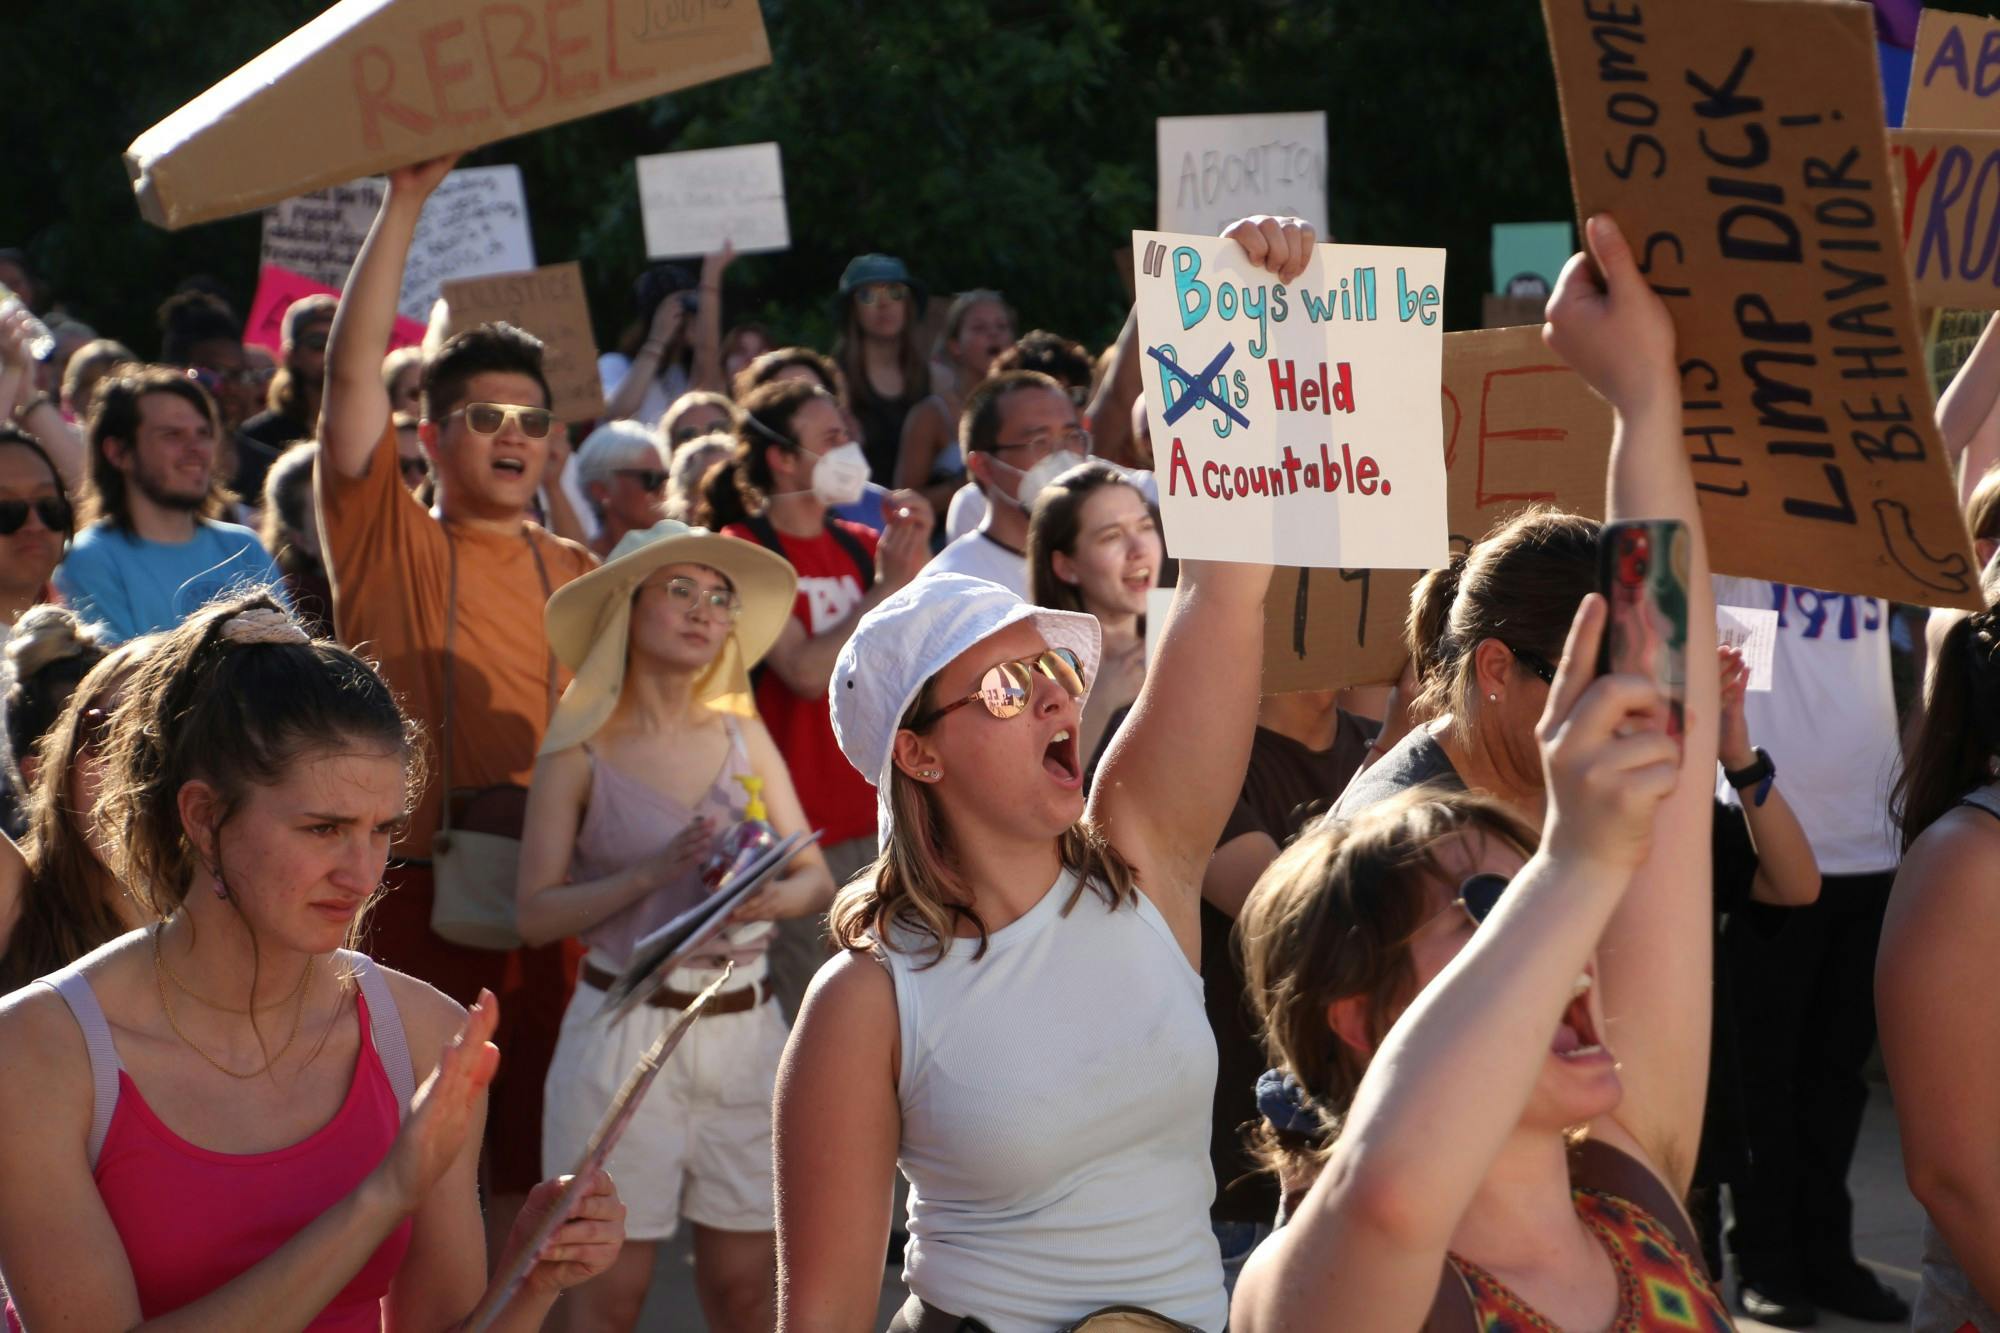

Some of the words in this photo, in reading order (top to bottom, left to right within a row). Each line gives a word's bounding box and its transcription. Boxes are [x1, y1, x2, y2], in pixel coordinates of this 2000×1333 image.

[351, 0, 658, 151] REBEL
[1684, 46, 1804, 265] DICK
[1301, 266, 1377, 324] will
[1396, 267, 1440, 327] be
[1267, 358, 1356, 416] Held
[1733, 293, 1858, 525] LIMP
[1168, 436, 1392, 501] Accountable.
